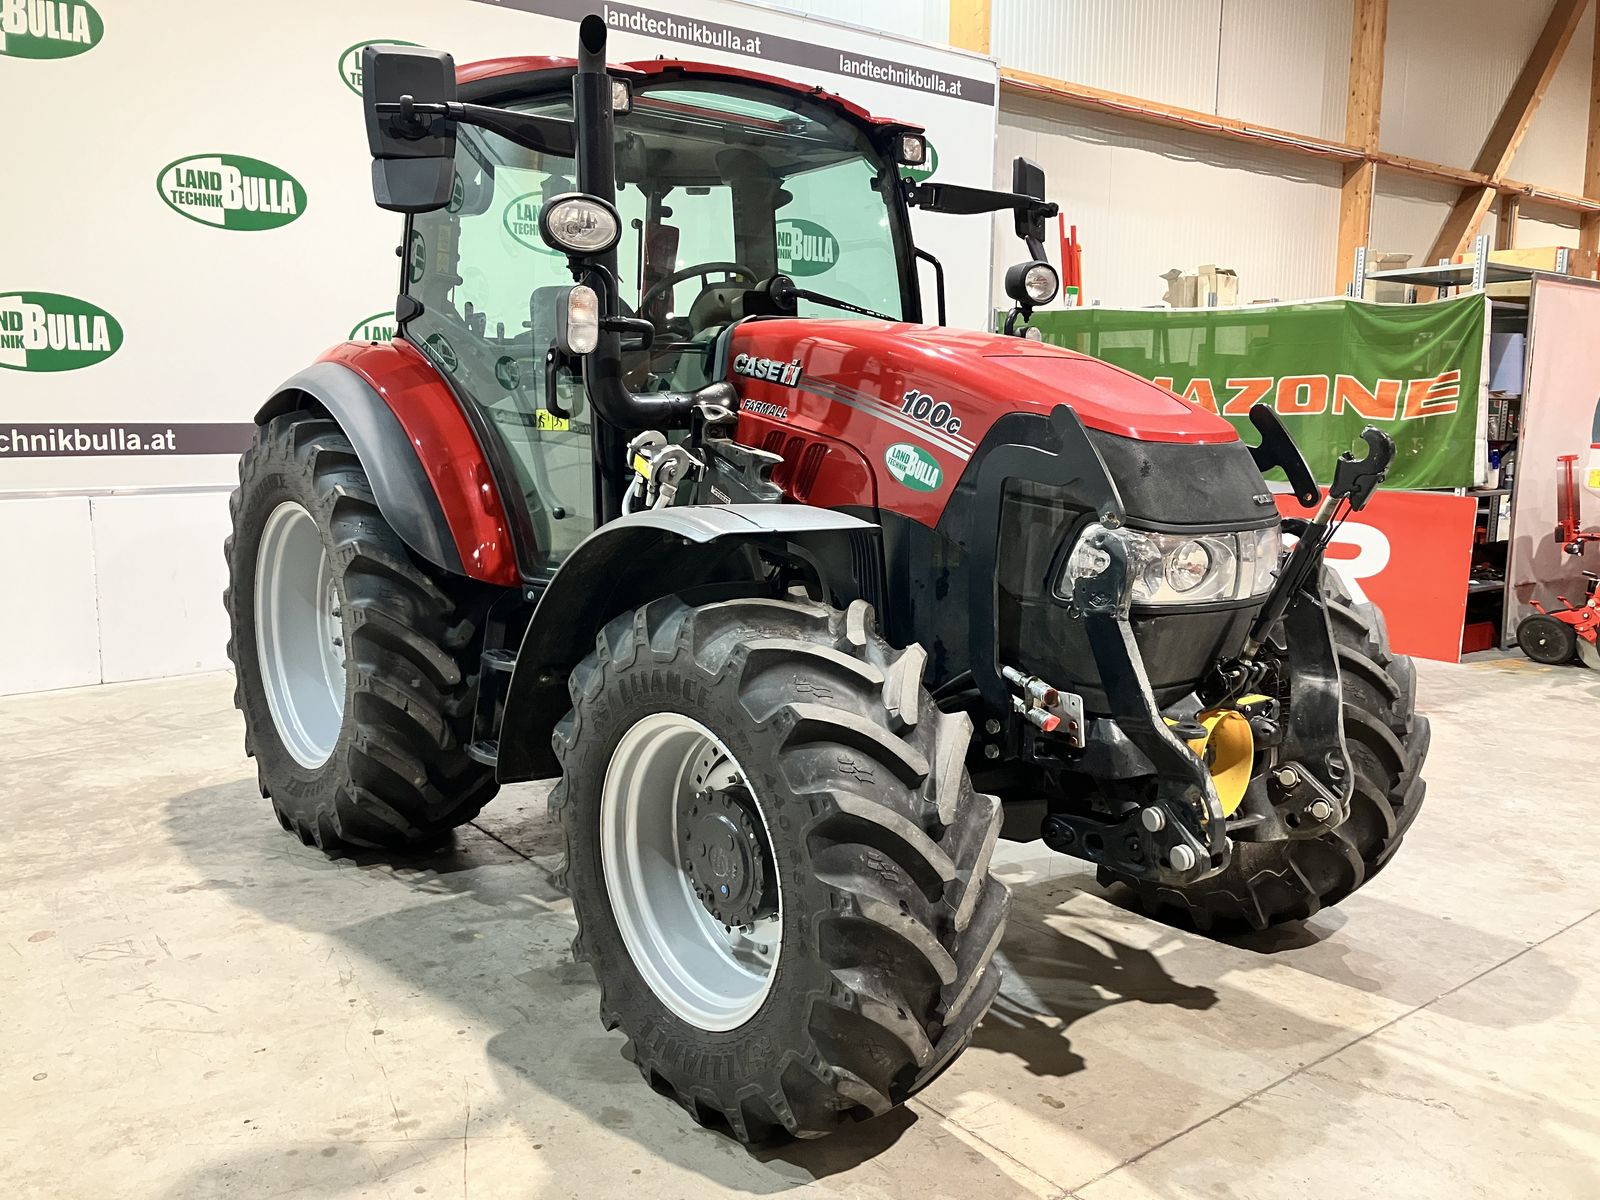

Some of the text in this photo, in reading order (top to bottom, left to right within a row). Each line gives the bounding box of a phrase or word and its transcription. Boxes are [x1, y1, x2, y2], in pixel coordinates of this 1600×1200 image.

[2, 0, 91, 44] BULLA
[603, 4, 761, 54] landtechnikbulla.at
[838, 54, 962, 96] landtechnikbulla.at
[175, 167, 222, 191] LAND
[221, 164, 297, 214] BULLA
[170, 189, 223, 208] TECHNIK
[516, 203, 542, 221] LAN
[512, 222, 539, 236] TECH
[777, 231, 791, 247] ND
[790, 227, 833, 263] BULLA
[0, 310, 23, 331] ND
[22, 303, 111, 351] BULLA
[364, 325, 394, 341] LAN
[1152, 369, 1461, 421] AZONE
[740, 398, 788, 418] FARMALL
[0, 428, 176, 452] chnikbulla.at
[892, 447, 911, 464] LAND
[909, 450, 940, 488] BULLA
